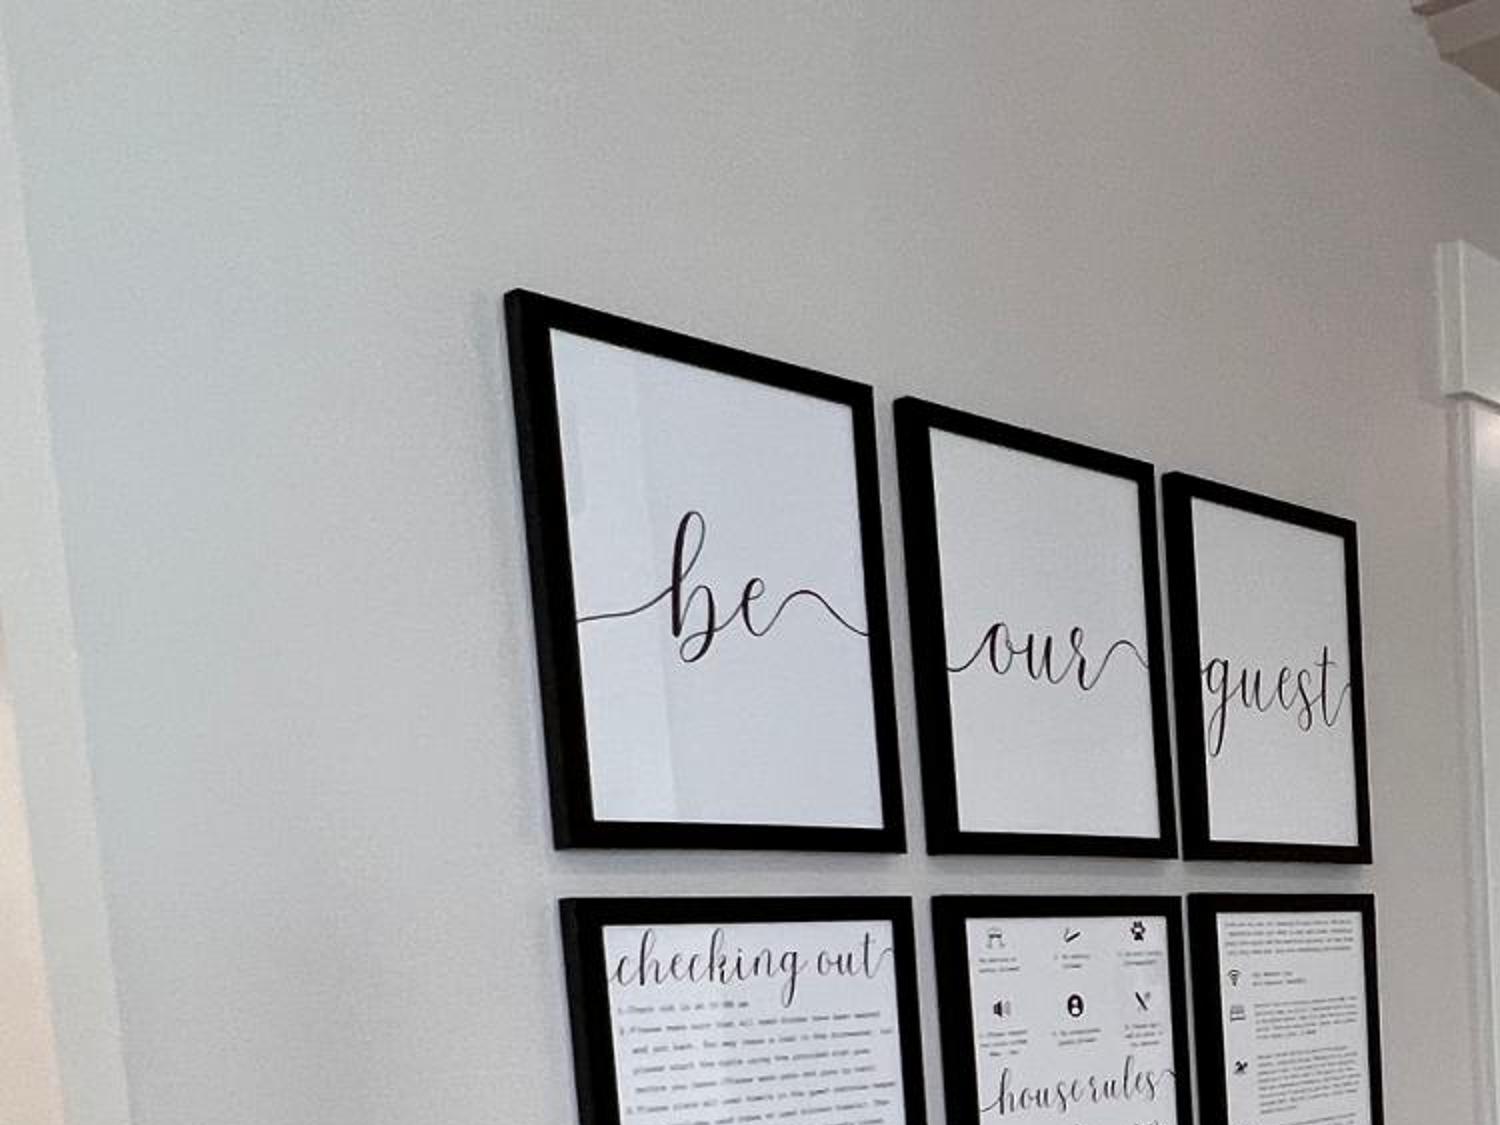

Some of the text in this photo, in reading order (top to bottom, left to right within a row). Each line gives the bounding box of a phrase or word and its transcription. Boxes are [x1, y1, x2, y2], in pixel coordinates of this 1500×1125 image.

[947, 621, 1149, 691] our
[1200, 645, 1351, 758] guest
[610, 927, 893, 1008] checking out
